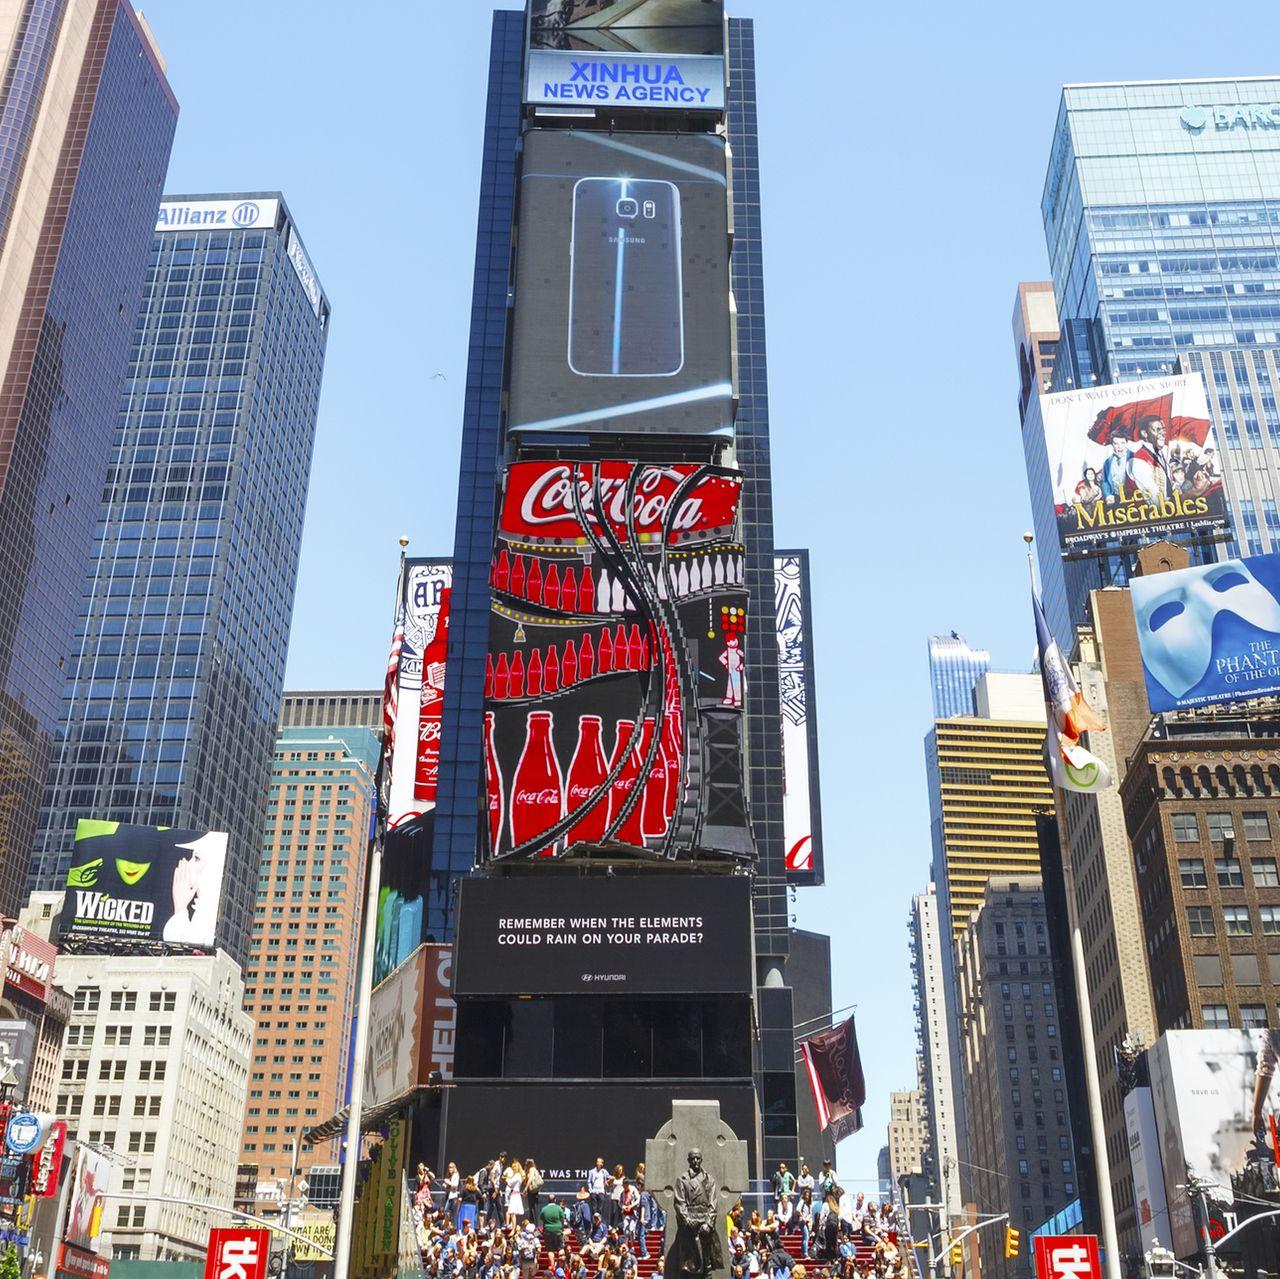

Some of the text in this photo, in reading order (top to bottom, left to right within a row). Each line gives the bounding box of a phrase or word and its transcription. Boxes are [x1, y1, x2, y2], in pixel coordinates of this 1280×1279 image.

[570, 62, 684, 85] XINHUA
[544, 83, 710, 103] NEWS AGENCY
[157, 207, 227, 225] Allianz
[1085, 389, 1111, 401] WAIT
[1112, 387, 1133, 397] ONE
[1137, 382, 1156, 393] DAY
[1160, 378, 1188, 390] MORE
[1118, 484, 1152, 503] Les
[1074, 490, 1208, 530] Misérables
[1065, 522, 1185, 544] BROADWAY'S IMPERIAL THEATRE
[1249, 641, 1271, 652] THE
[1225, 674, 1241, 684] OF
[1243, 670, 1265, 681] THE
[1180, 696, 1207, 706] MAJESTIC
[1208, 692, 1231, 701] THEATRE
[498, 917, 703, 929] REMEMBER WHEN THE ELEMENTS
[498, 933, 704, 945] COULD RAIN ON YOUR PARADE?
[549, 1169, 571, 1178] WAS
[380, 1185, 396, 1253] GARDEN
[314, 1226, 329, 1235] ARE
